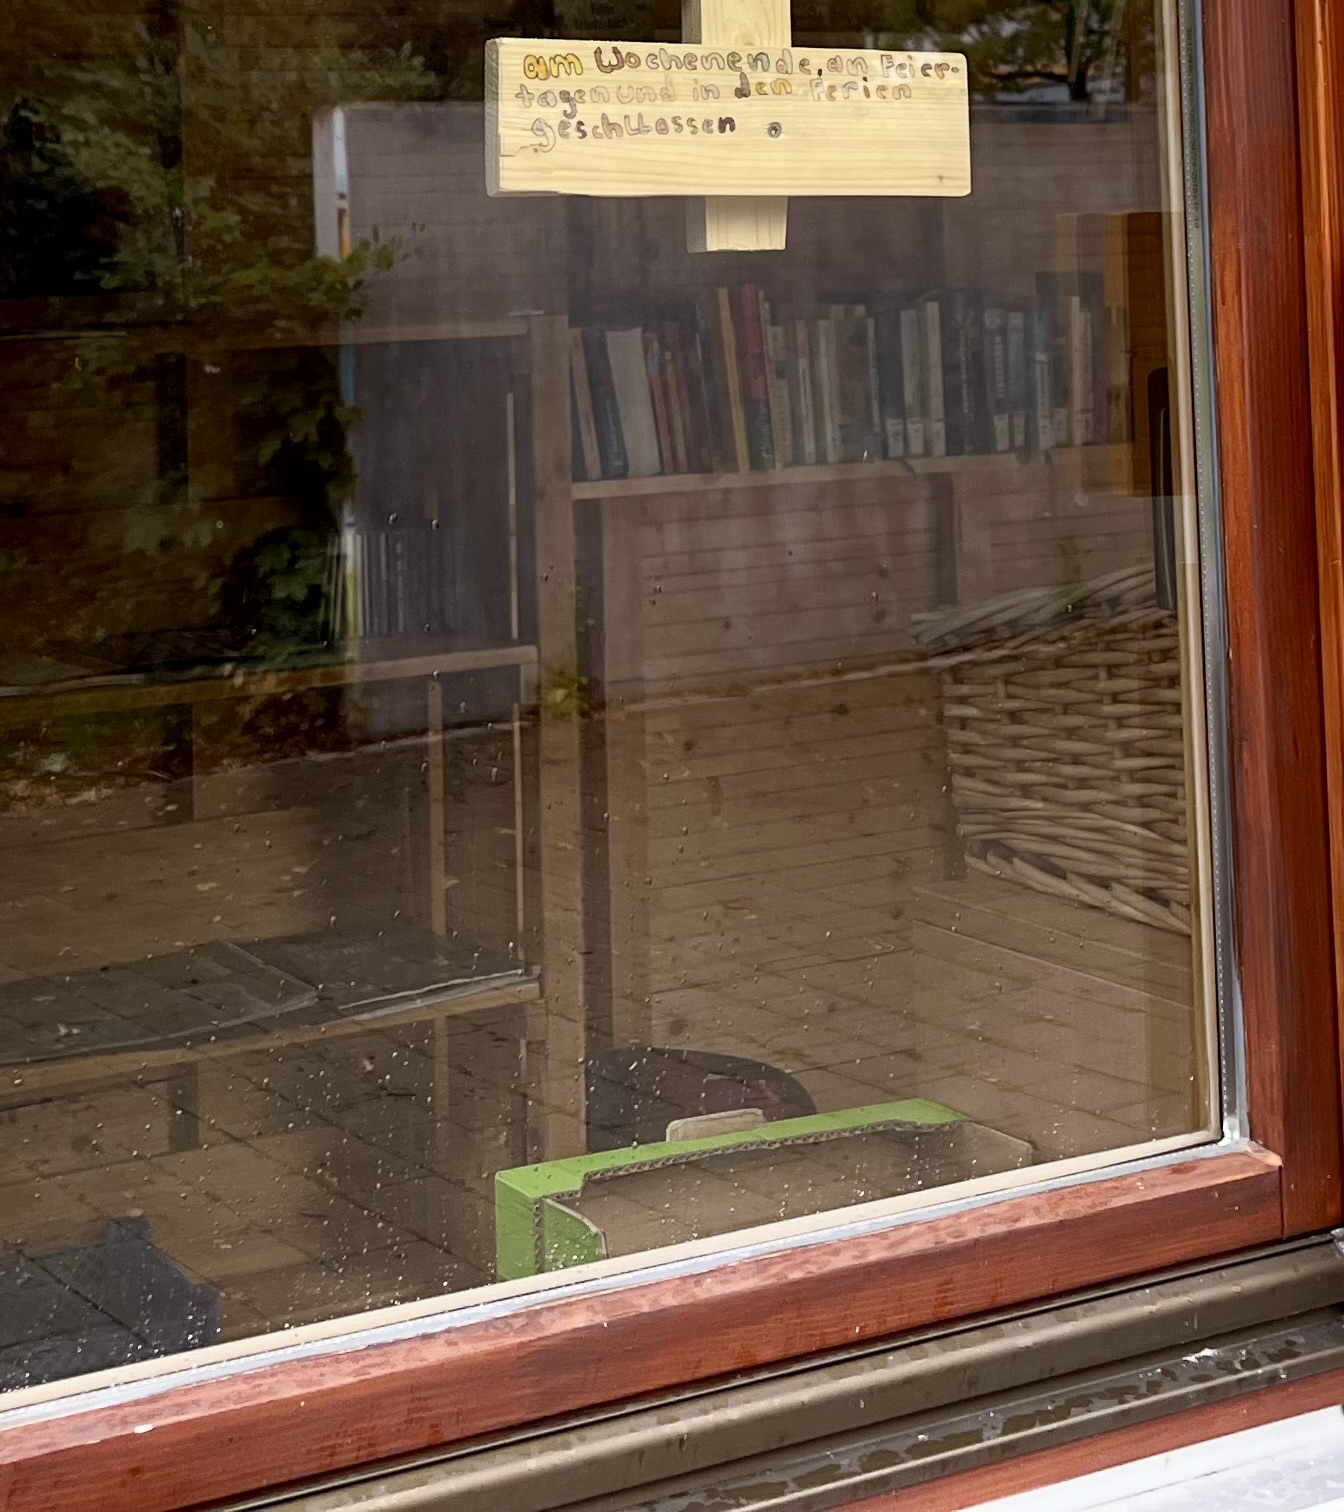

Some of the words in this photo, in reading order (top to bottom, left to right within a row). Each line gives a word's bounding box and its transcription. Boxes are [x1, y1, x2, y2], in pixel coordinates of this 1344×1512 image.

[523, 53, 584, 81] am
[692, 78, 721, 101] in
[733, 71, 793, 100] den
[808, 76, 913, 102] Ferien
